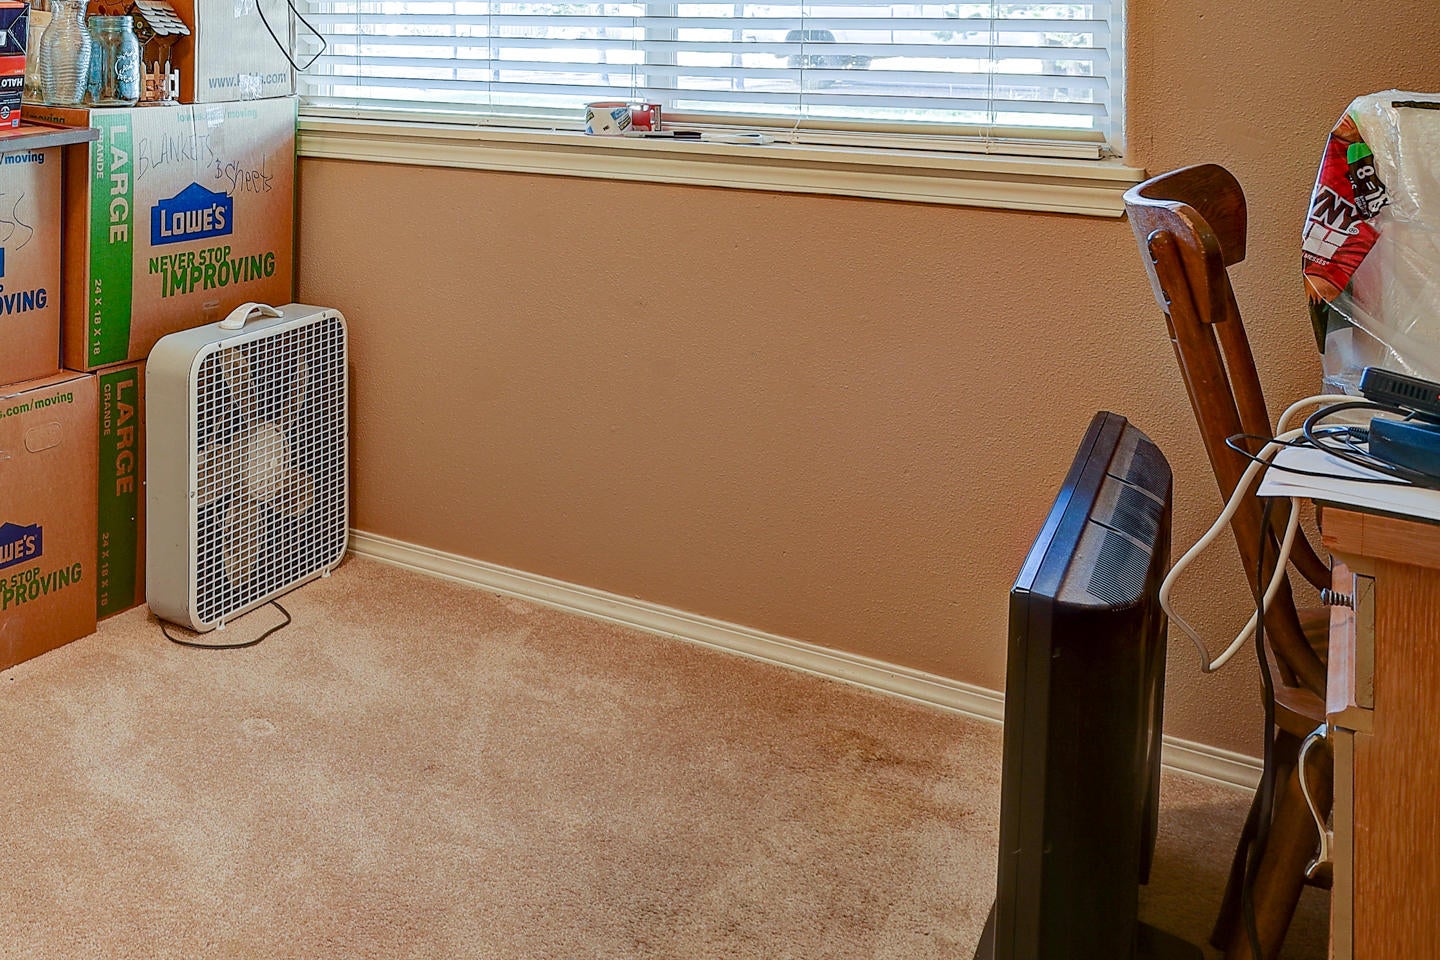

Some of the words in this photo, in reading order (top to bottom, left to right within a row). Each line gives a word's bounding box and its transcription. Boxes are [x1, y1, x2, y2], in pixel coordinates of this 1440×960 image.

[137, 132, 214, 181] BLANKETS
[225, 153, 274, 196] Sheets
[1356, 165, 1375, 179] 8
[108, 125, 129, 246] LARGE
[160, 204, 226, 237] LOWE'S
[148, 252, 195, 275] NEVER
[198, 245, 231, 265] STOP
[94, 279, 102, 294] 24
[94, 298, 101, 306] X
[94, 310, 101, 324] 18
[93, 327, 101, 336] X
[93, 340, 101, 356] 18
[103, 383, 111, 437] GRANDE
[115, 379, 134, 497] LARGE
[101, 532, 109, 548] 24
[101, 551, 109, 559] X
[10, 567, 41, 588] STOP
[101, 564, 109, 578] 18
[101, 580, 108, 589] X
